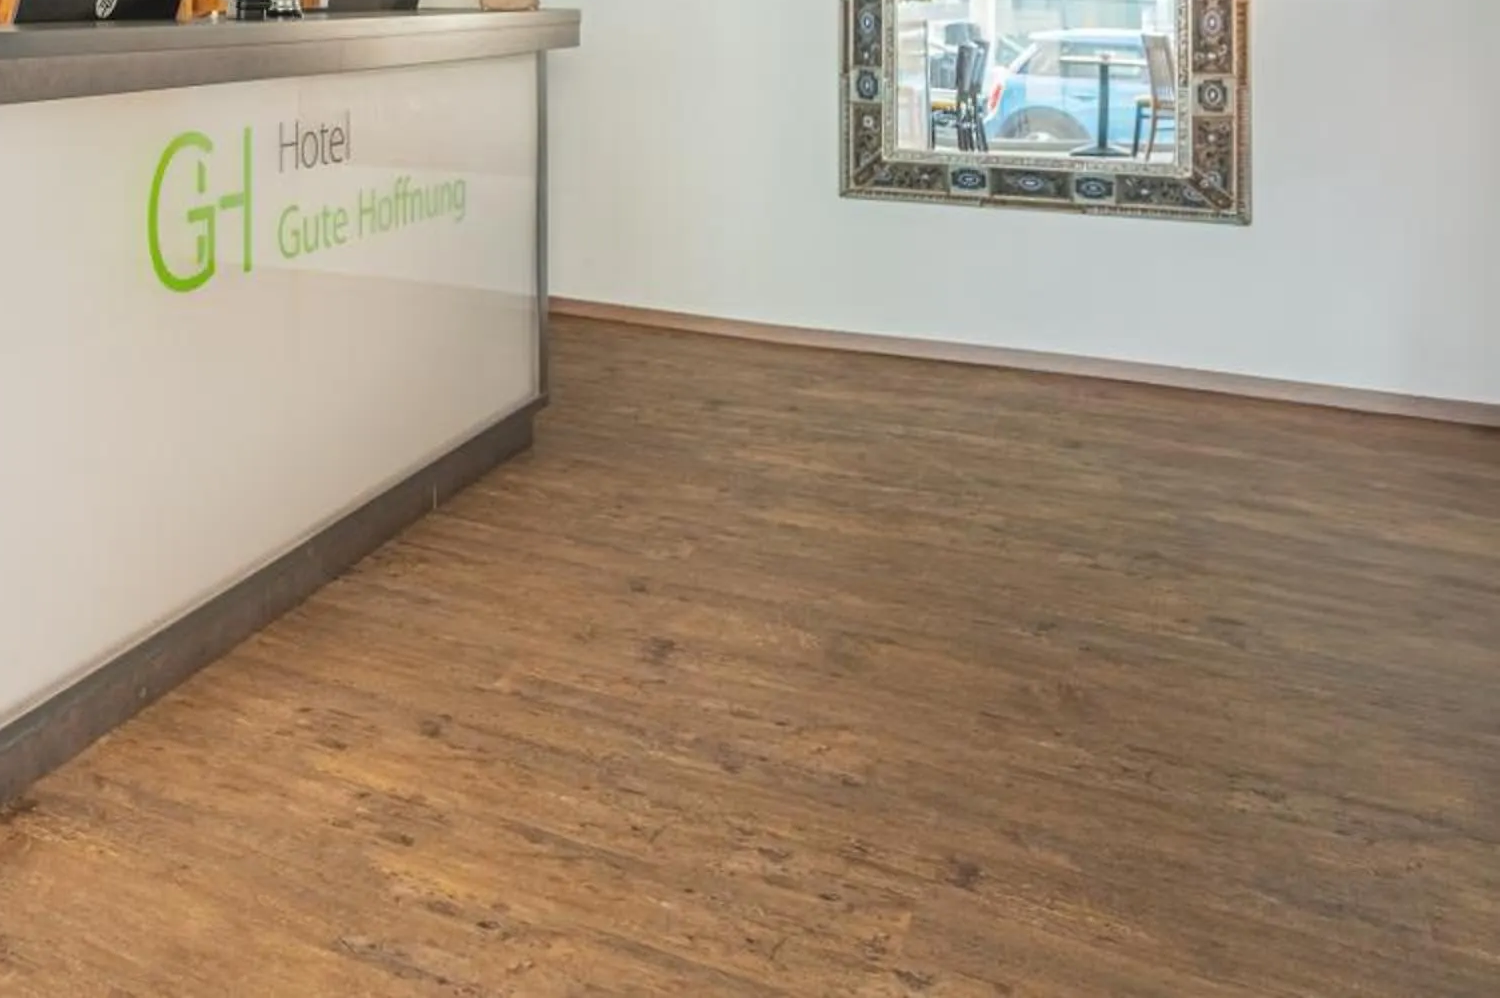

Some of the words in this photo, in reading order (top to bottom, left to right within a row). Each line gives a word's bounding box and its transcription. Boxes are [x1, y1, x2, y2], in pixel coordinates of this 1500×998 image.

[279, 110, 351, 173] Hotel
[278, 203, 349, 259] Gute
[358, 176, 466, 239] Hoffnung
